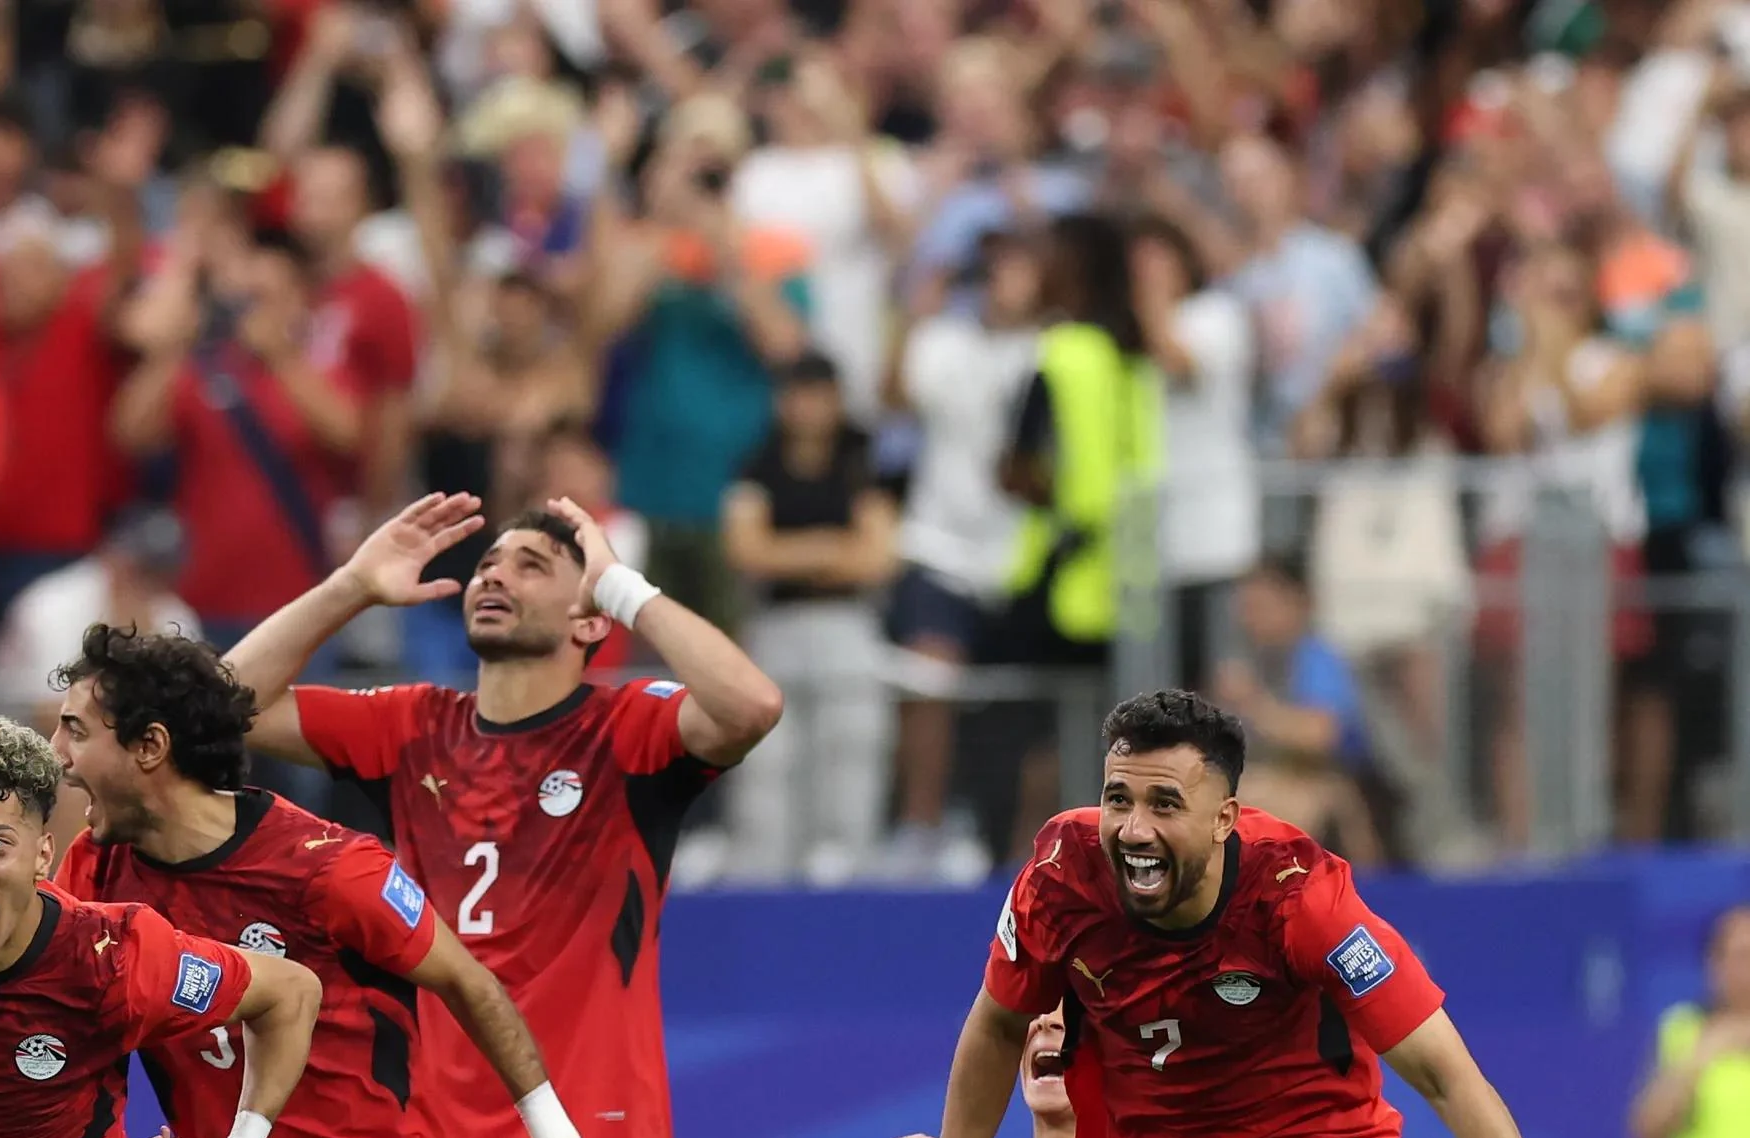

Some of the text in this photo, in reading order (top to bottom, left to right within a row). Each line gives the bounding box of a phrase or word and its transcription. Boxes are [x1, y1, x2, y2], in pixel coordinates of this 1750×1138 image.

[457, 841, 500, 935] 2
[1337, 937, 1367, 964] FOOTBALL
[1343, 944, 1374, 974] UNITES
[186, 965, 202, 1000] UNITES
[1139, 1019, 1181, 1072] 7
